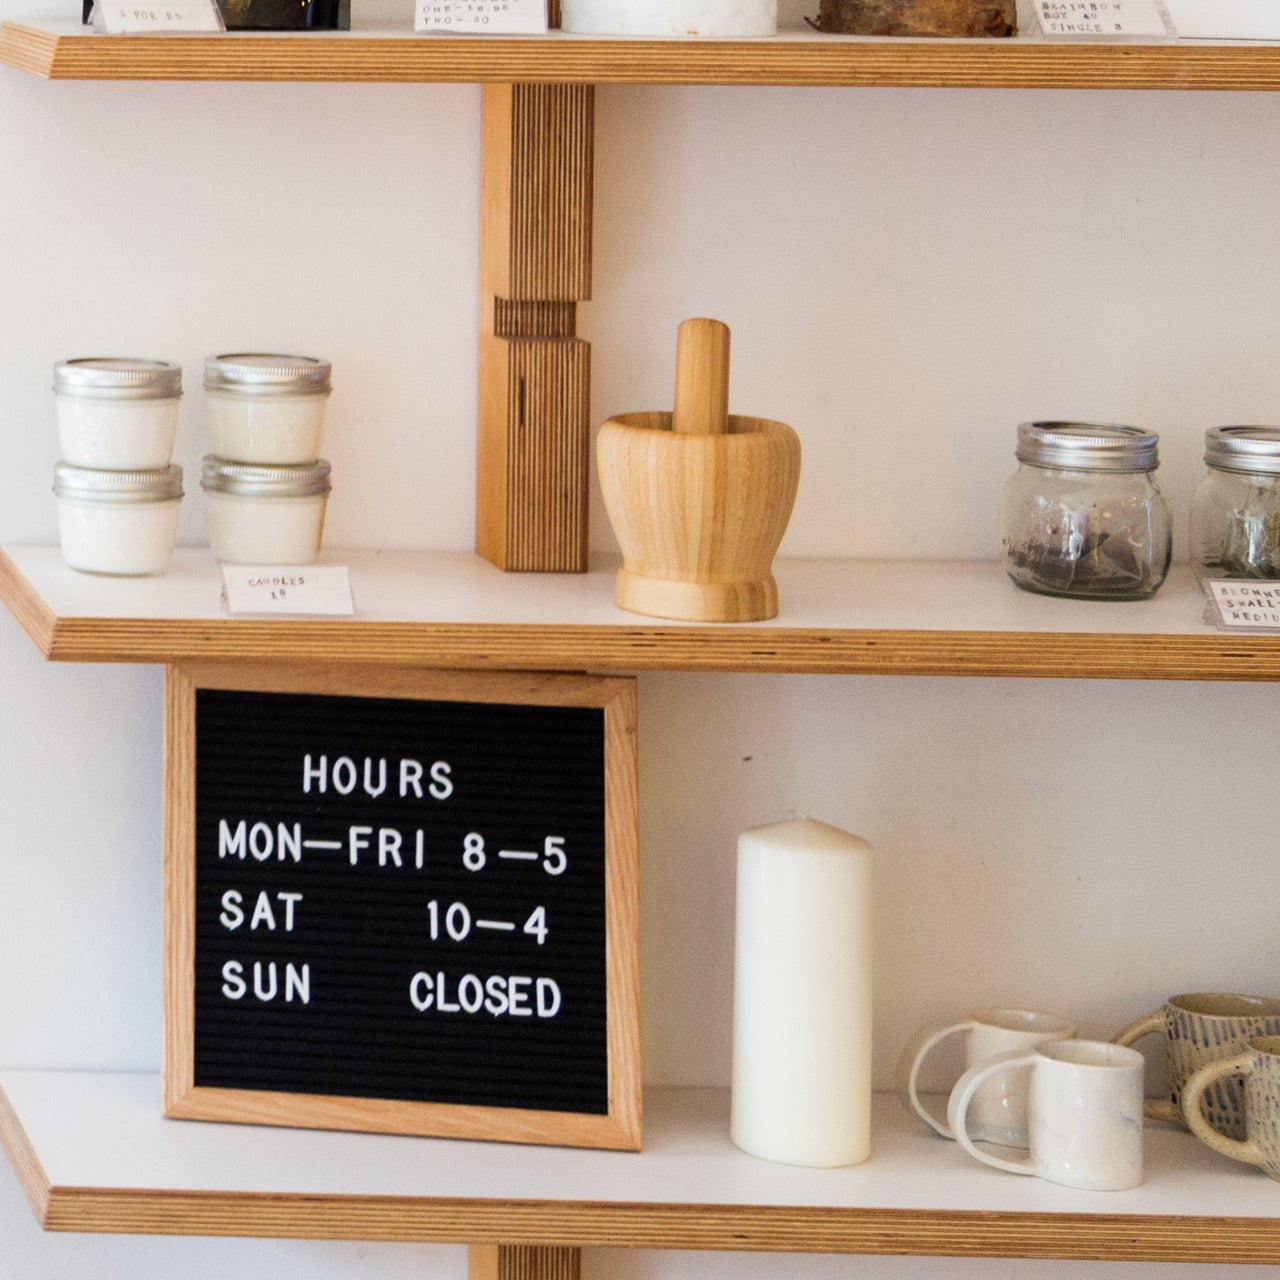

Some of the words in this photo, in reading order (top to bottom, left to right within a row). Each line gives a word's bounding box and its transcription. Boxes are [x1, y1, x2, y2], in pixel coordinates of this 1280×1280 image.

[133, 10, 158, 20] FOR
[1043, 11, 1068, 20] BOX
[1050, 23, 1103, 32] SINGLE
[248, 576, 305, 587] CANDLES
[303, 754, 453, 799] HOURS
[220, 890, 303, 931] SAT
[222, 961, 309, 1004] SUN
[410, 972, 561, 1017] CLOSED
